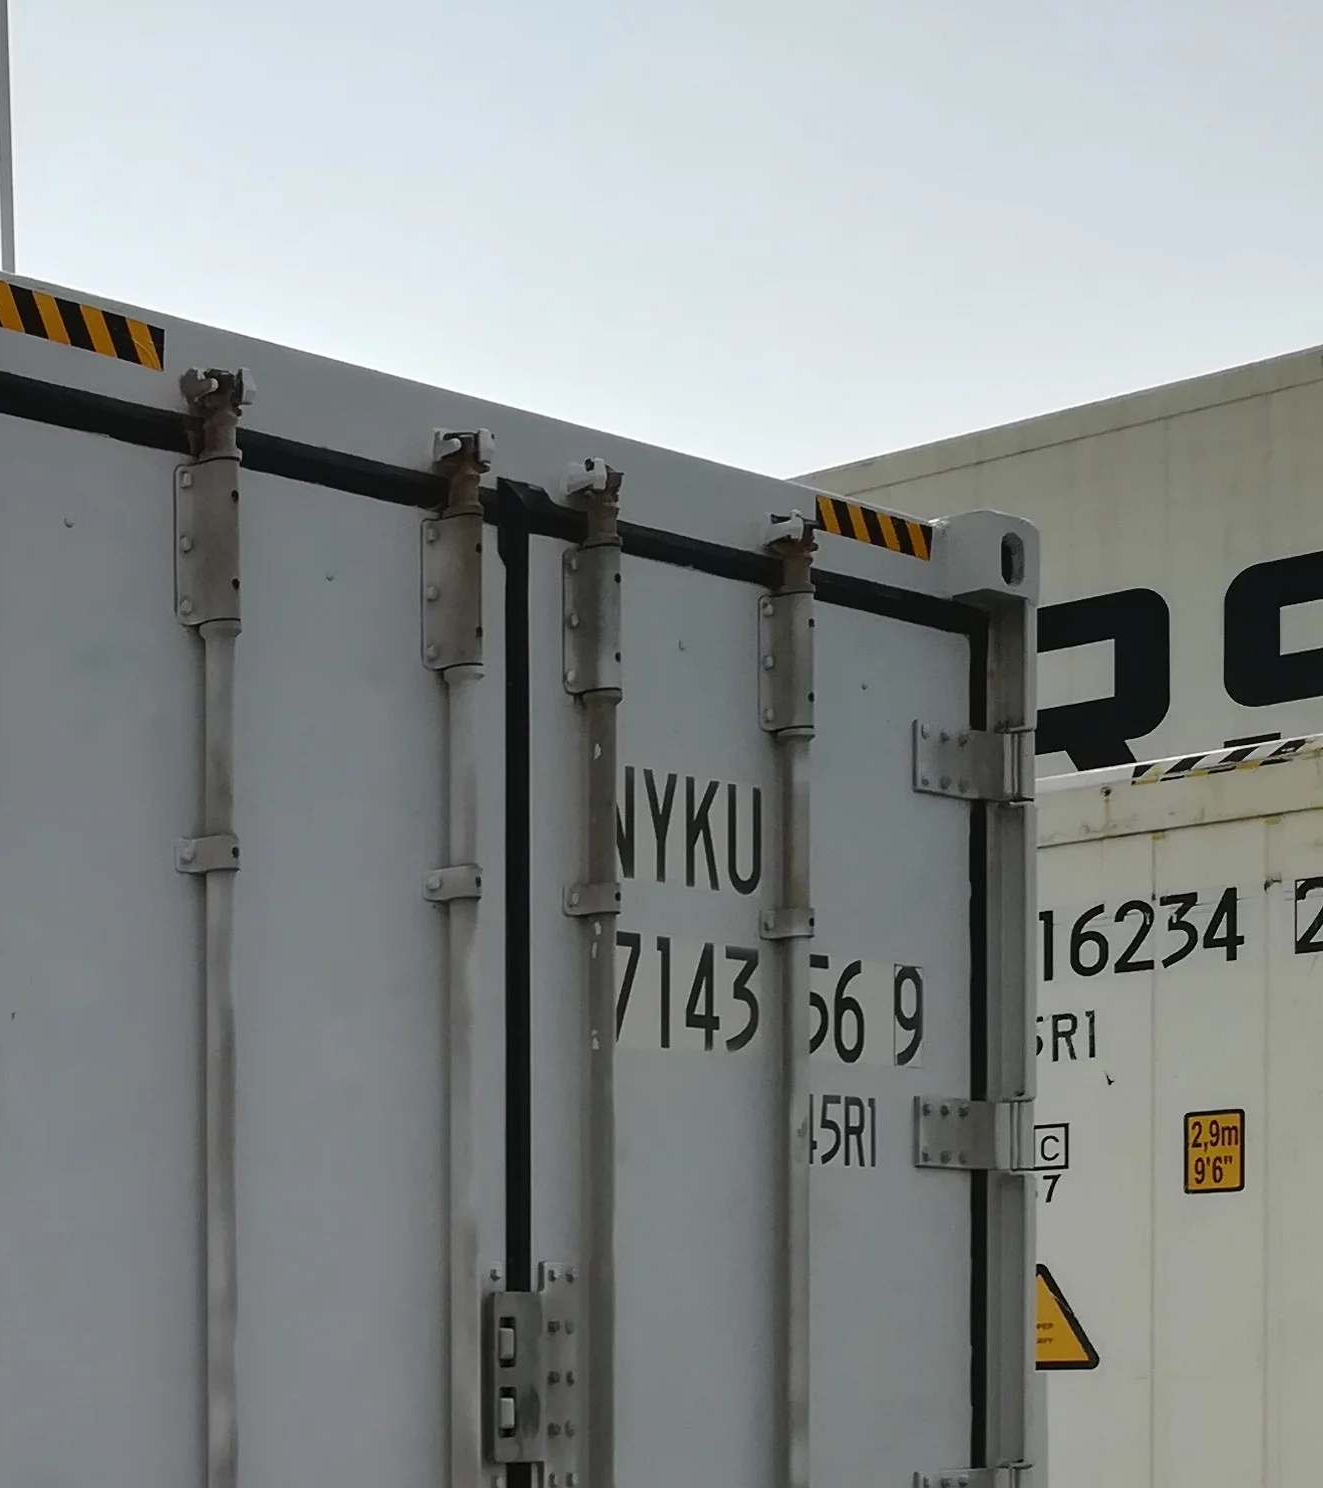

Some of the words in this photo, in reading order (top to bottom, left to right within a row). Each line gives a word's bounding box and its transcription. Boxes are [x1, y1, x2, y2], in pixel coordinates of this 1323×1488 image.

[894, 965, 923, 1066] 9
[1040, 1135, 1060, 1162] C
[1191, 1119, 1239, 1152] 2,9m
